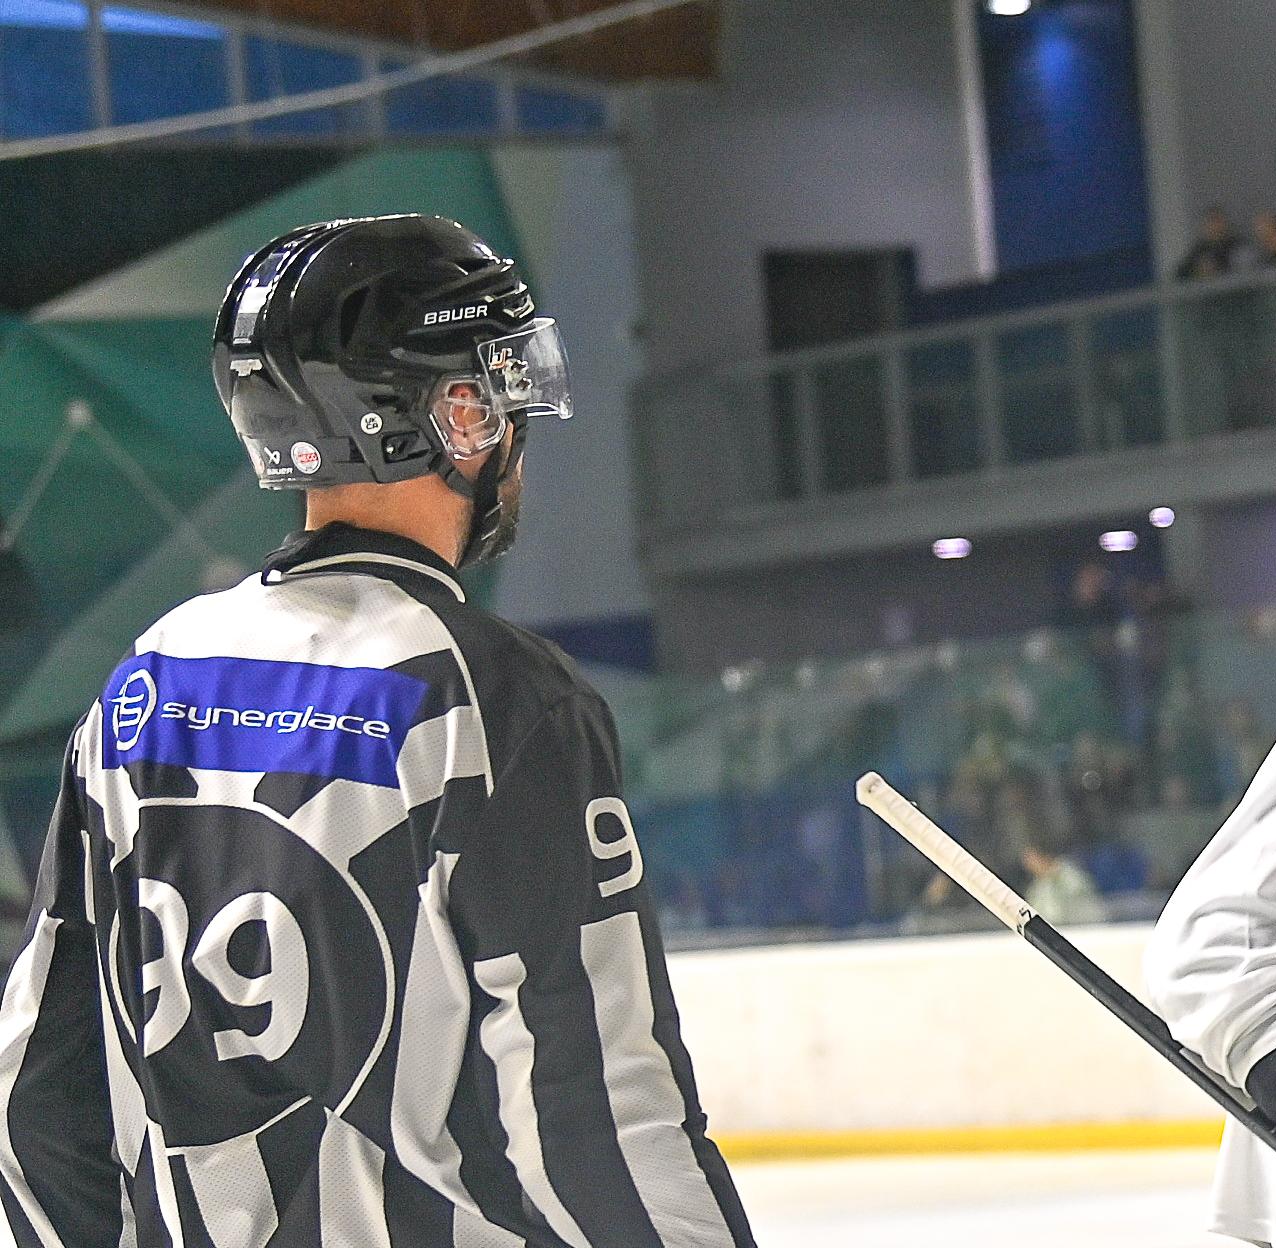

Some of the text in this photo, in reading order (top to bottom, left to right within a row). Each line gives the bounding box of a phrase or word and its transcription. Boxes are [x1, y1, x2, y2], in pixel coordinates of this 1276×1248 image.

[423, 304, 488, 326] BAUER
[160, 701, 391, 739] synerglace
[584, 796, 644, 898] 9
